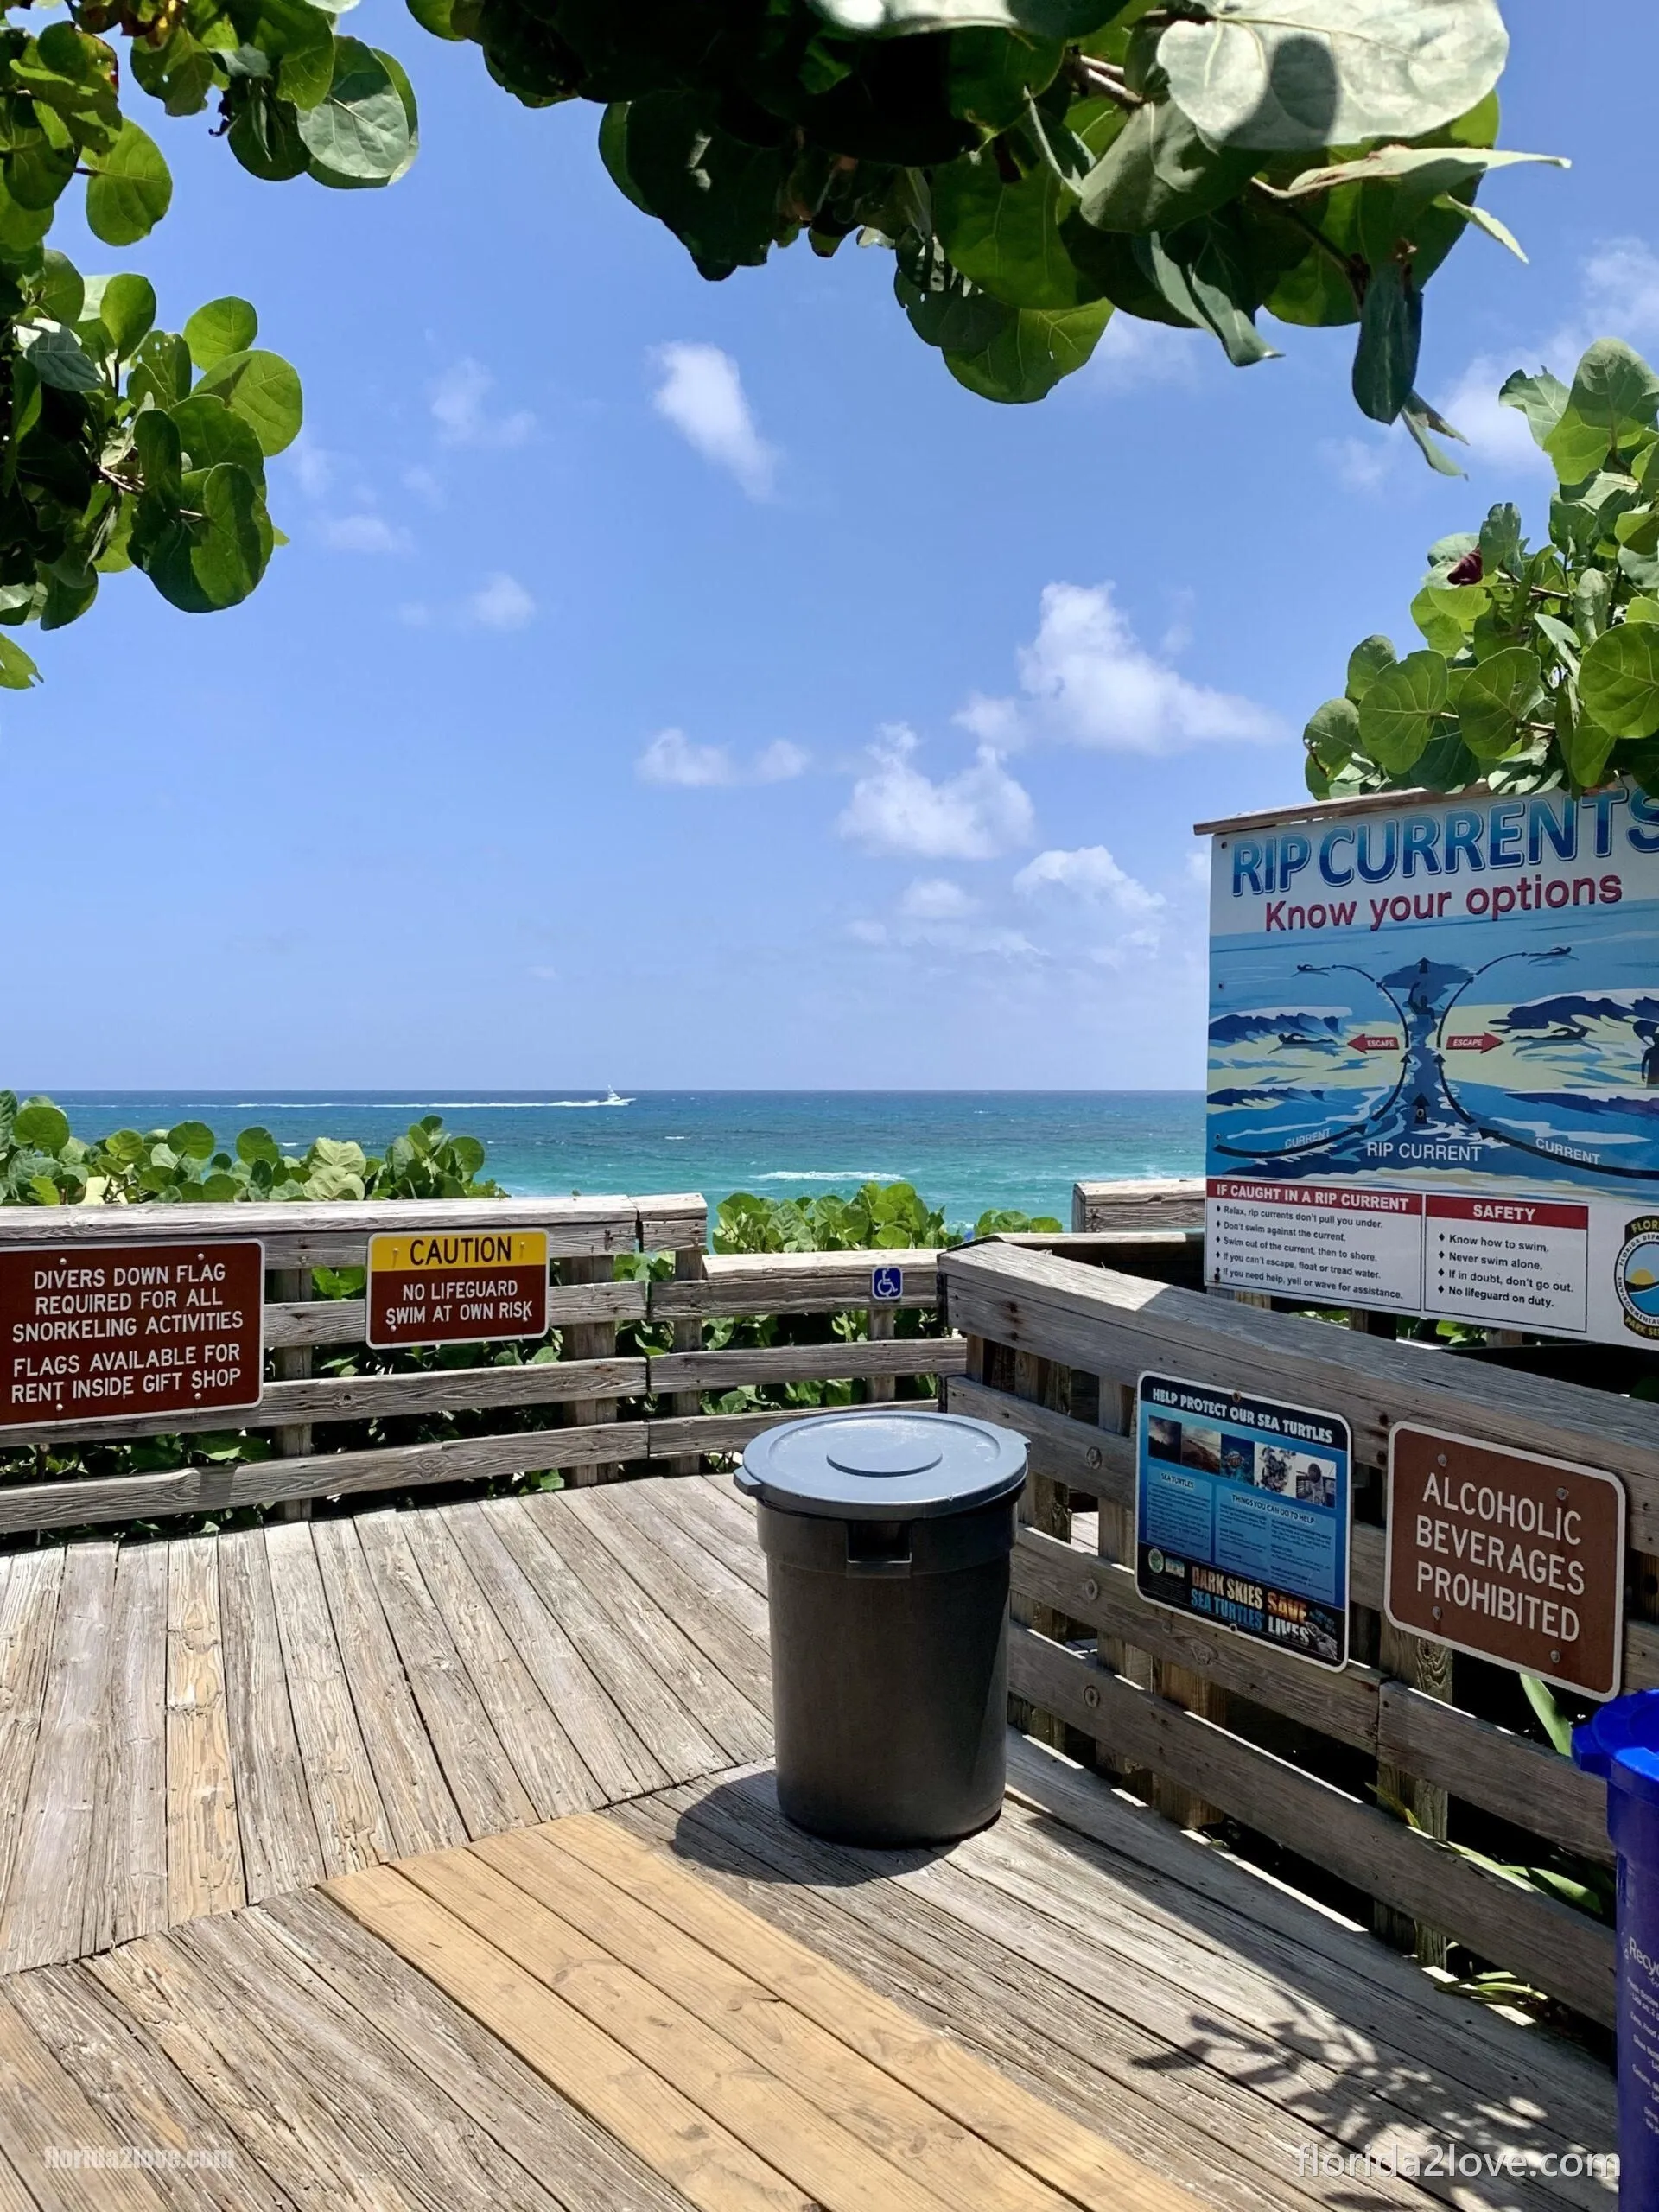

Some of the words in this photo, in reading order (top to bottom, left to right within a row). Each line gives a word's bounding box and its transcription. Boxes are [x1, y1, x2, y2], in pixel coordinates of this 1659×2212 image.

[1232, 833, 1311, 896] RIP
[1318, 787, 1659, 886] CURRENTS
[1266, 900, 1357, 931] Know
[1370, 892, 1452, 931] your
[1465, 874, 1623, 921] options
[1285, 1128, 1330, 1148] CURRENT
[1367, 1141, 1390, 1158] RIP
[1399, 1143, 1482, 1161] CURRENT
[1536, 1139, 1600, 1165] CURRENT
[1217, 1185, 1229, 1195] IF
[1231, 1185, 1281, 1201] CAUGHT
[1285, 1190, 1298, 1201] IN
[1302, 1191, 1313, 1203] A
[1315, 1192, 1337, 1205] RIP
[1341, 1193, 1408, 1211] CURRENT
[1224, 1206, 1246, 1217] Relax,
[1248, 1208, 1259, 1217] rip
[1261, 1211, 1293, 1220] currents
[1296, 1213, 1317, 1222] don't
[1319, 1216, 1334, 1224] pull
[1337, 1217, 1353, 1226] you
[1356, 1219, 1382, 1229] under.
[1473, 1204, 1535, 1221] SAFETY
[1267, 1226, 1296, 1237] against
[1298, 1229, 1312, 1238] the
[1313, 1231, 1346, 1242] current.
[1449, 1235, 1478, 1245] Know
[1481, 1237, 1502, 1247] how
[1505, 1240, 1516, 1249] to
[1518, 1242, 1549, 1252] swim.
[410, 1236, 512, 1265] CAUTION
[1224, 1237, 1243, 1246] Swim
[1245, 1240, 1257, 1249] out
[1284, 1245, 1315, 1255] current,
[1318, 1248, 1336, 1256] then
[1350, 1251, 1377, 1262] shore.
[1449, 1252, 1478, 1263] Never
[1481, 1255, 1508, 1266] swim
[1511, 1259, 1542, 1270] alone.
[34, 1269, 105, 1289] DIVERS
[113, 1267, 168, 1286] DOWN
[176, 1263, 226, 1282] FLAG
[1224, 1252, 1229, 1261] If
[1230, 1255, 1244, 1263] you
[1246, 1255, 1264, 1264] can't
[1266, 1259, 1296, 1269] escape,
[1299, 1262, 1317, 1271] float
[1331, 1266, 1352, 1275] tread
[1355, 1270, 1381, 1279] water.
[403, 1284, 424, 1301] NO
[431, 1281, 518, 1300] LIFEGUARD
[1230, 1270, 1244, 1279] you
[1246, 1271, 1263, 1281] need
[1266, 1274, 1286, 1284] help,
[1287, 1277, 1302, 1286] yell
[1315, 1281, 1336, 1290] wave
[1338, 1282, 1351, 1292] for
[1353, 1286, 1403, 1299] assistance.
[1458, 1270, 1467, 1280] in
[1471, 1272, 1503, 1285] doubt,
[1506, 1277, 1533, 1287] don't
[1535, 1281, 1549, 1291] go
[1553, 1282, 1573, 1292] out.
[35, 1293, 132, 1315] REQUIRED
[140, 1291, 177, 1310] FOR
[186, 1288, 223, 1306] ALL
[1449, 1287, 1463, 1295] No
[1465, 1287, 1510, 1301] lifeguard
[1528, 1296, 1554, 1307] duty.
[385, 1306, 425, 1325] SWIM
[432, 1305, 452, 1322] AT
[460, 1303, 493, 1321] OWN
[499, 1301, 532, 1319] RISK
[13, 1318, 137, 1343] SNORKELING
[145, 1311, 243, 1334] ACTIVITIES
[14, 1355, 80, 1377] FLAGS
[89, 1346, 197, 1372] AVAILABLE
[204, 1344, 240, 1363] FOR
[11, 1381, 64, 1403] RENT
[73, 1376, 134, 1399] INSIDE
[143, 1373, 183, 1393] GIFT
[191, 1368, 241, 1389] SHOP
[1153, 1389, 1178, 1404] HELP
[1180, 1394, 1227, 1417] PROTECT
[1230, 1406, 1255, 1425] OUR
[1258, 1414, 1279, 1430] SEA
[1282, 1419, 1332, 1443] TURTLES
[1171, 1476, 1194, 1488] TURTLES
[1232, 1495, 1253, 1507] THINGS
[1253, 1501, 1266, 1510] YOU
[1267, 1505, 1279, 1515] CAN
[1279, 1509, 1289, 1517] DO
[1299, 1513, 1314, 1524] HELP
[1422, 1472, 1581, 1546] ALCOHOLIC
[1416, 1514, 1585, 1596] BEVERAGES
[1192, 1566, 1224, 1597] DARK
[1227, 1578, 1263, 1610] SKIES
[1268, 1592, 1307, 1623] SAVE
[1417, 1560, 1580, 1642] PROHIBITED
[1191, 1588, 1212, 1611] SEA
[1268, 1616, 1310, 1646] LIVES
